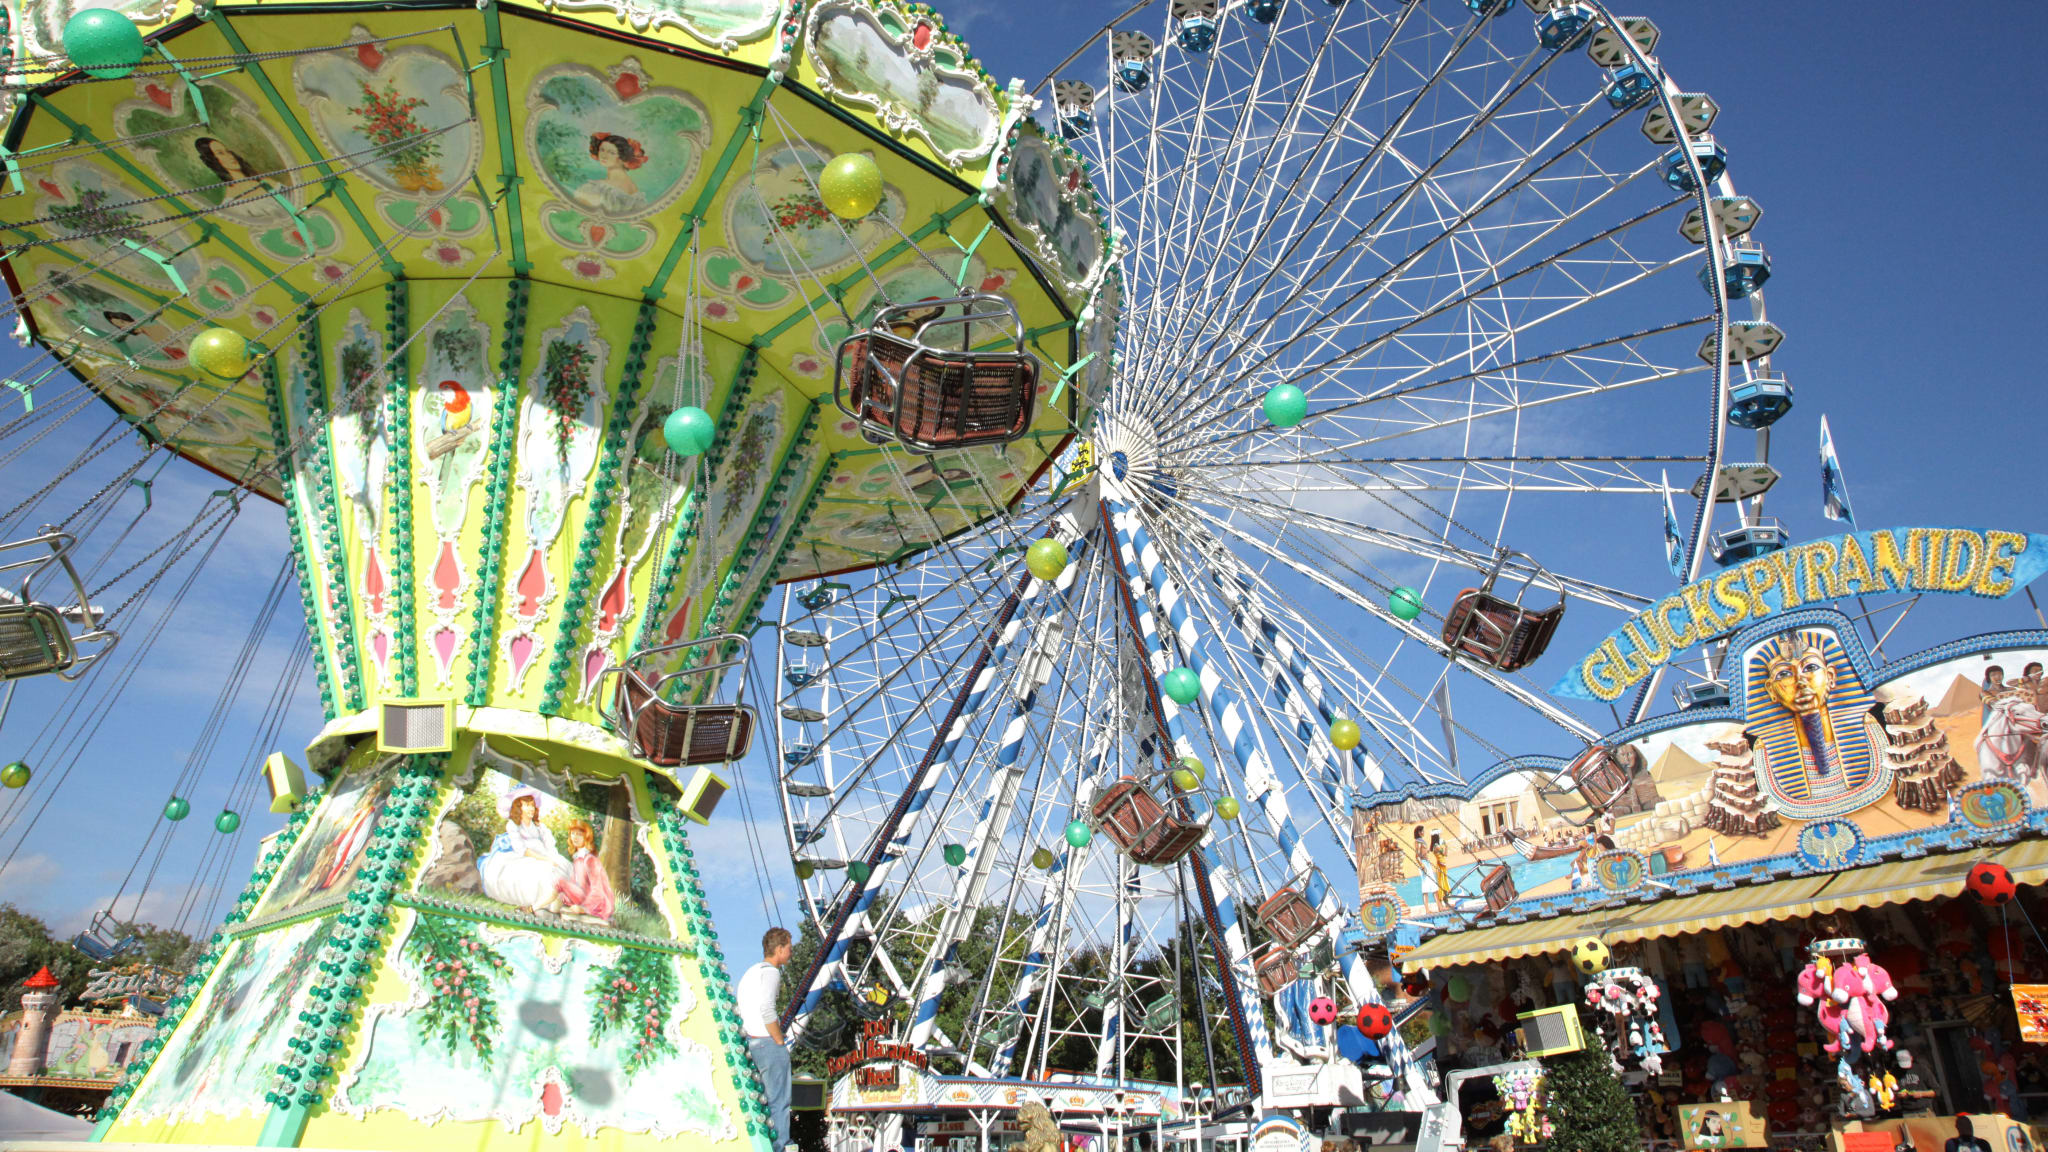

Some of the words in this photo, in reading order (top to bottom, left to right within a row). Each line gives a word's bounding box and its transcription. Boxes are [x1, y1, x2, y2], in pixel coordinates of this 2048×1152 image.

[826, 1043, 864, 1077] Royal
[867, 1040, 928, 1070] Bavarian
[855, 1065, 896, 1086] Wheel
